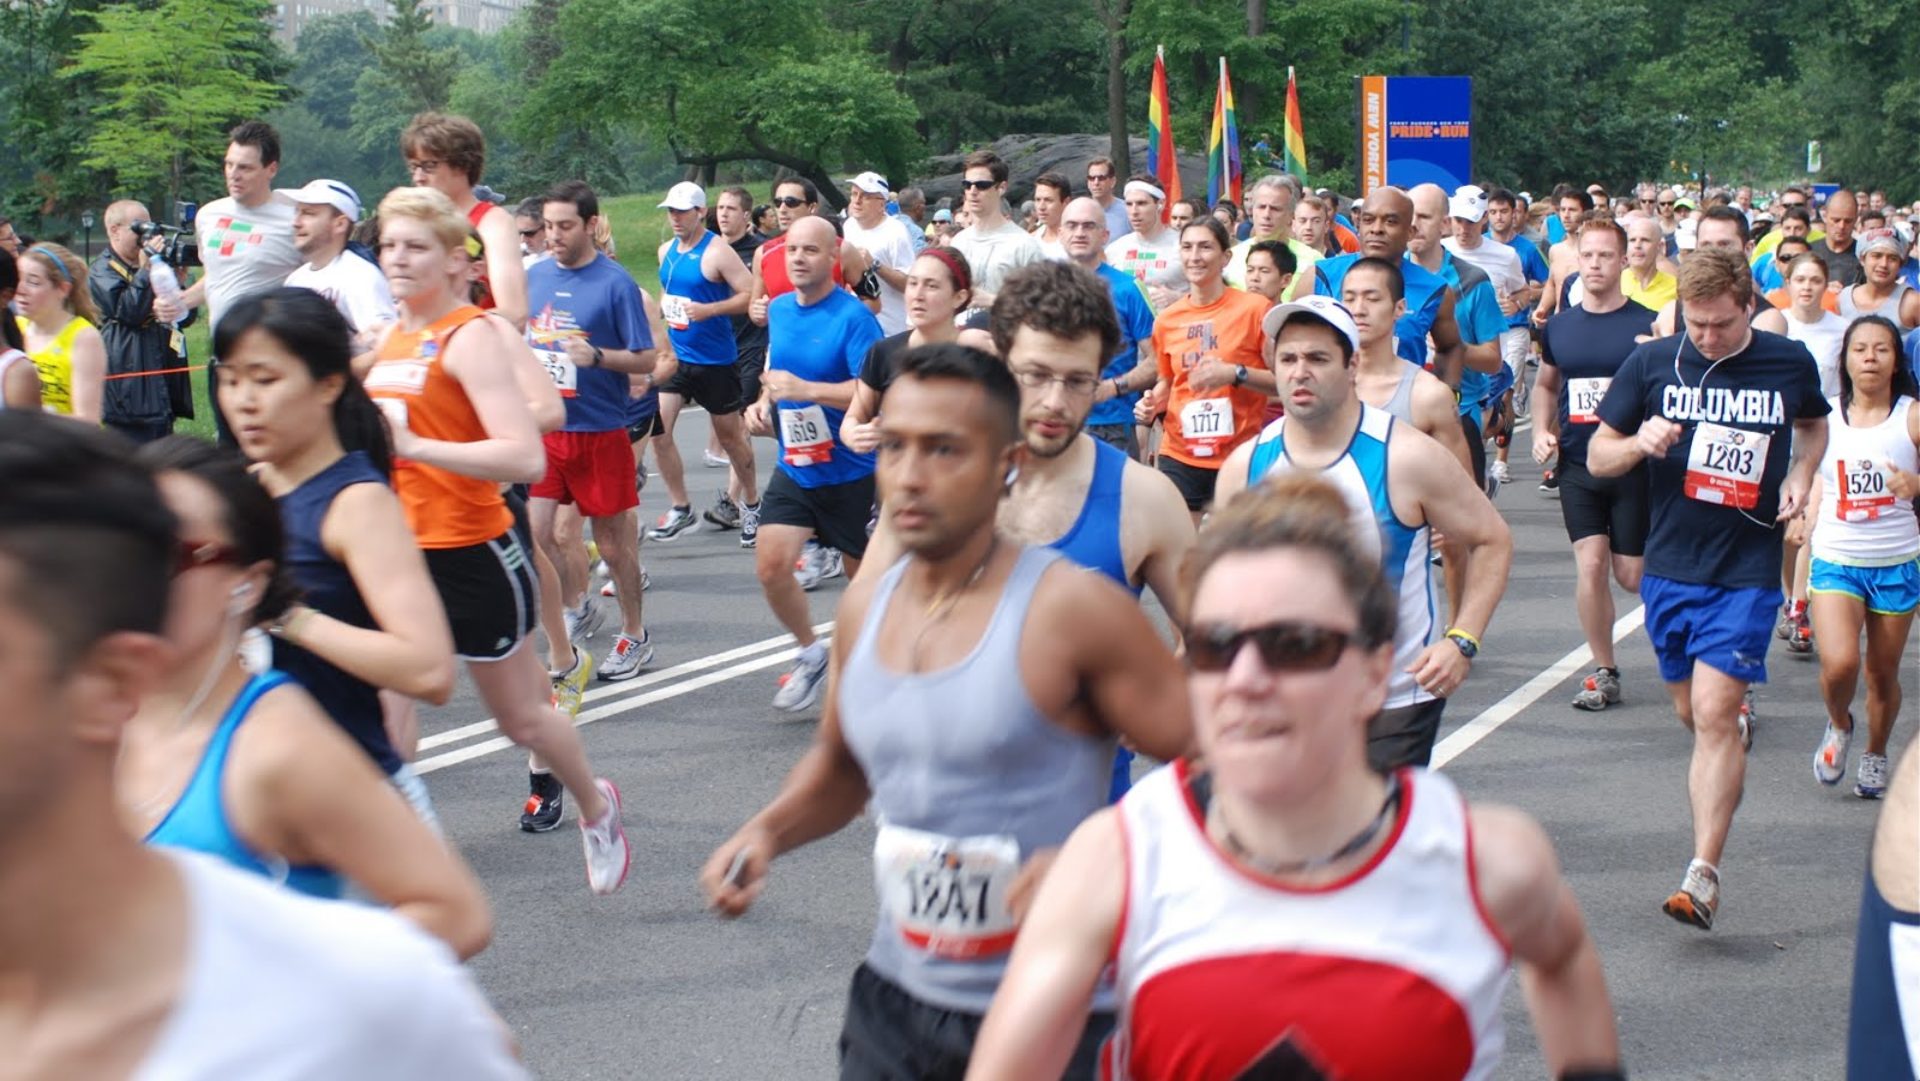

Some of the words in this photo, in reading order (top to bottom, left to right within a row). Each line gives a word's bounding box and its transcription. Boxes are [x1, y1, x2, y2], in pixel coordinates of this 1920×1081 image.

[1368, 91, 1380, 129] NEW
[1391, 125, 1433, 138] PRIDE
[1440, 125, 1469, 138] RUN
[1368, 130, 1380, 172] YORK
[1577, 391, 1606, 410] 135
[1663, 384, 1785, 424] COLUMBIA
[1192, 412, 1219, 433] 1717
[1702, 442, 1754, 475] 1203
[1845, 471, 1884, 494] 1520
